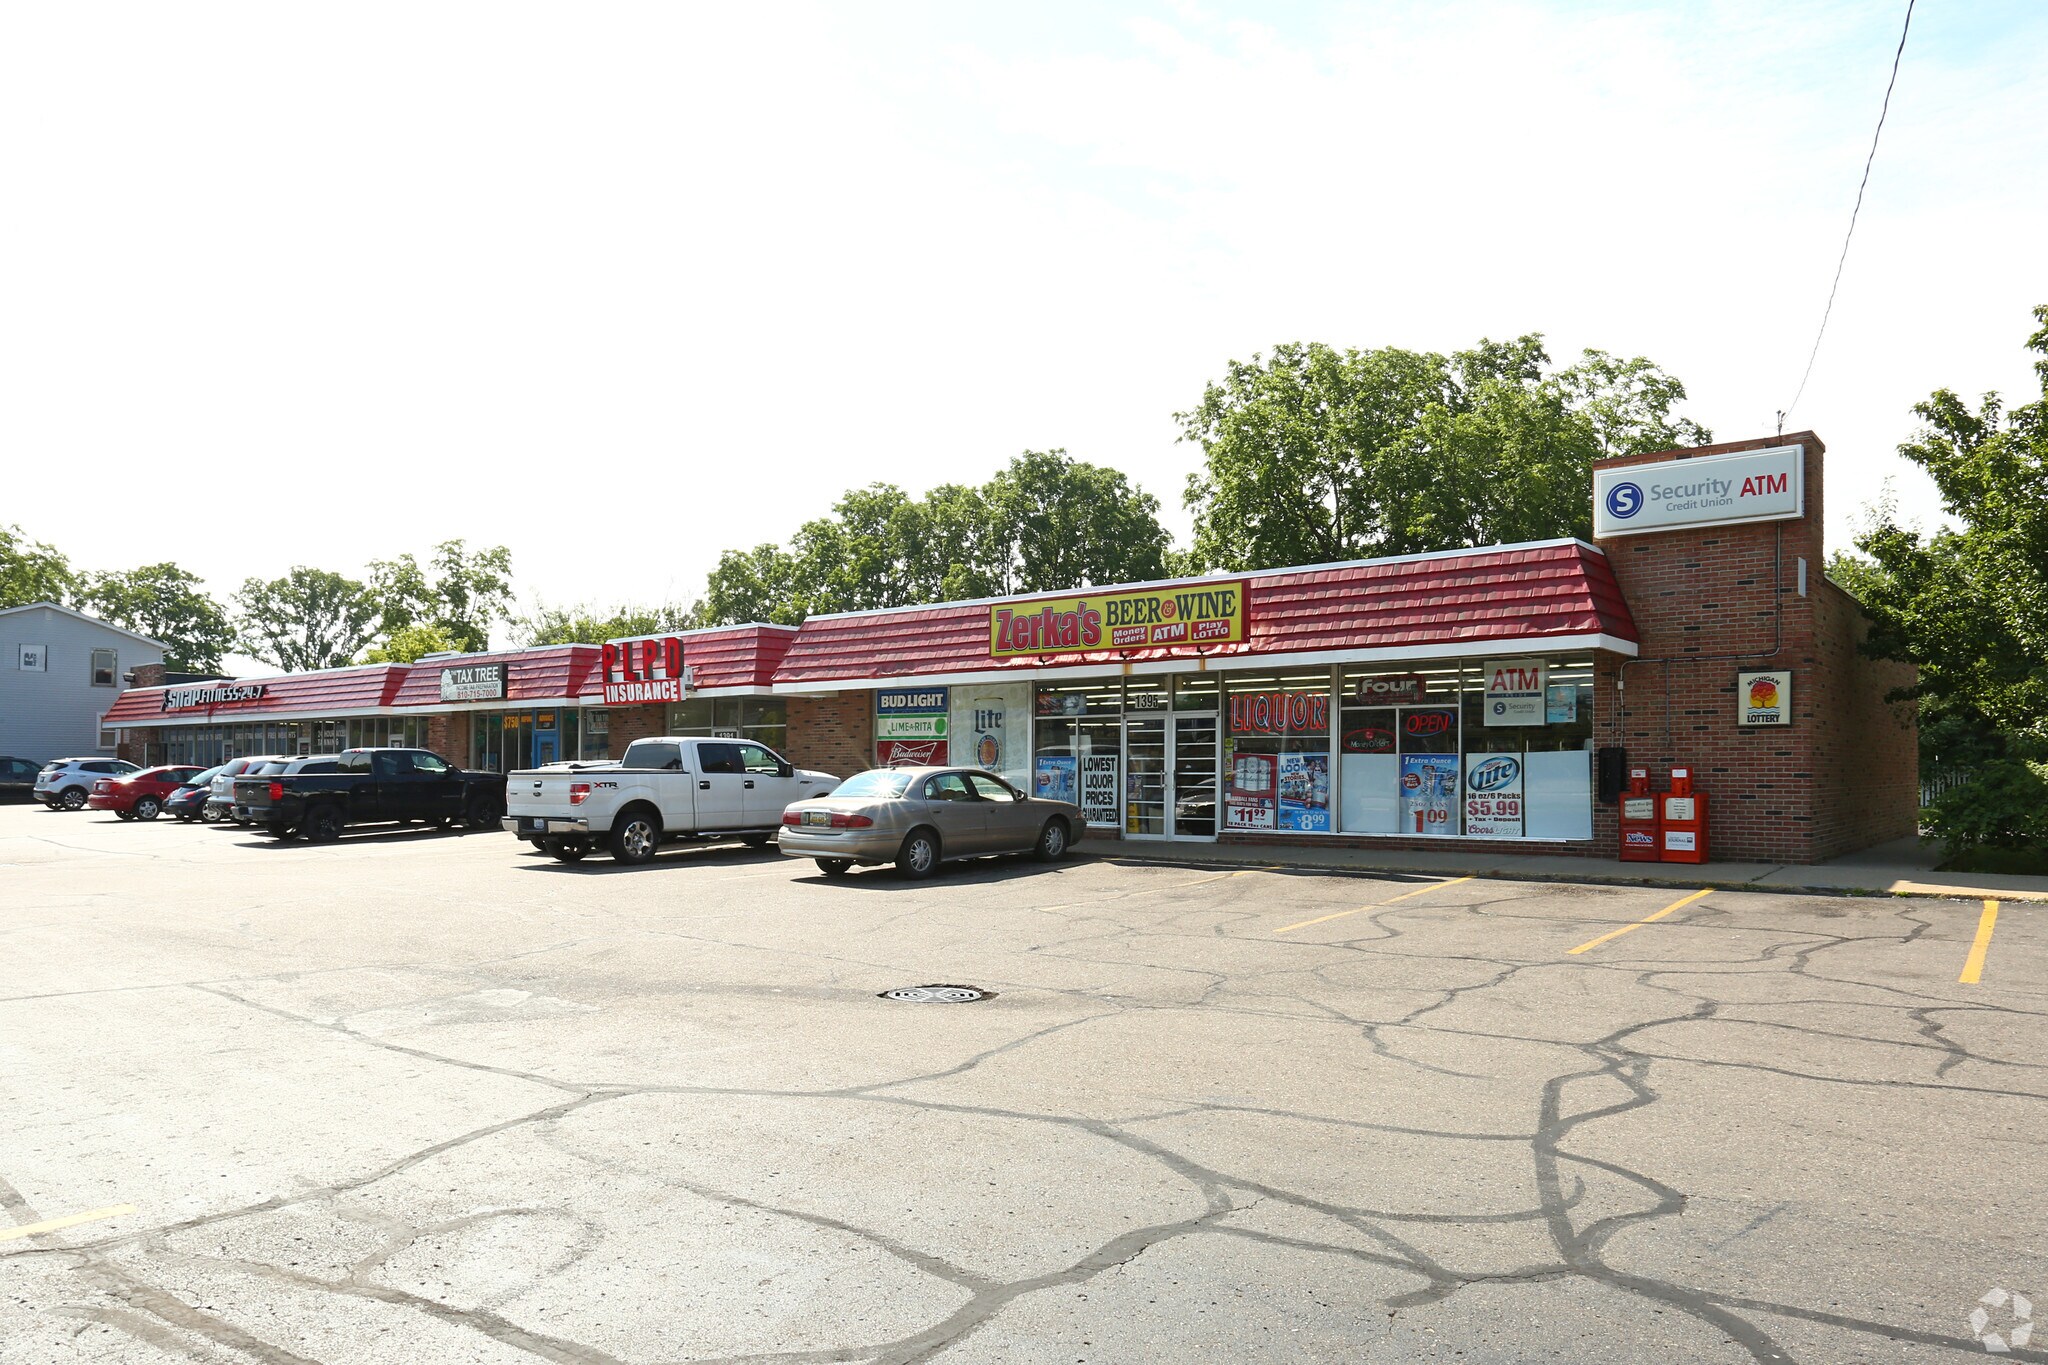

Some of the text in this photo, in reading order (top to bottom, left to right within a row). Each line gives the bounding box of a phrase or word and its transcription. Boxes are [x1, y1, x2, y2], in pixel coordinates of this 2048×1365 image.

[1651, 478, 1733, 501] Security
[1740, 473, 1788, 498] ATM
[1666, 496, 1733, 512] Credit Union
[996, 602, 1102, 652] Zerka's
[1106, 598, 1162, 627] BEER
[1175, 590, 1237, 621] WINE
[1198, 621, 1222, 631] Play
[1113, 627, 1146, 637] Money
[1113, 634, 1146, 645] Orders
[1153, 623, 1185, 642] ATM
[1193, 627, 1229, 640] LOTTO
[602, 637, 685, 683] PLPD
[457, 669, 473, 683] TAX
[475, 666, 499, 682] TREE
[1491, 667, 1539, 691] ATM
[1747, 676, 1781, 687] MICHIGAN
[457, 689, 497, 698] 810-715-7000
[606, 681, 678, 703] INSURANCE
[1362, 679, 1418, 694] four
[881, 693, 944, 708] BUD LIGHT
[1135, 694, 1159, 708] 1395
[1508, 703, 1536, 711] Security
[1231, 692, 1327, 732] LIQUOR
[1747, 714, 1780, 723] LOTTERY
[975, 709, 1002, 734] Lite
[1407, 714, 1450, 732] OPEN
[892, 746, 931, 759] Budweiser
[1083, 757, 1116, 772] LOWEST
[1405, 756, 1410, 765] 1
[1281, 764, 1307, 773] LOOK
[1085, 774, 1114, 790] LIQUOR
[1085, 791, 1114, 806] PRICES
[1468, 800, 1519, 817] $5.99
[1468, 824, 1493, 834] Coors
[1626, 833, 1653, 843] News
